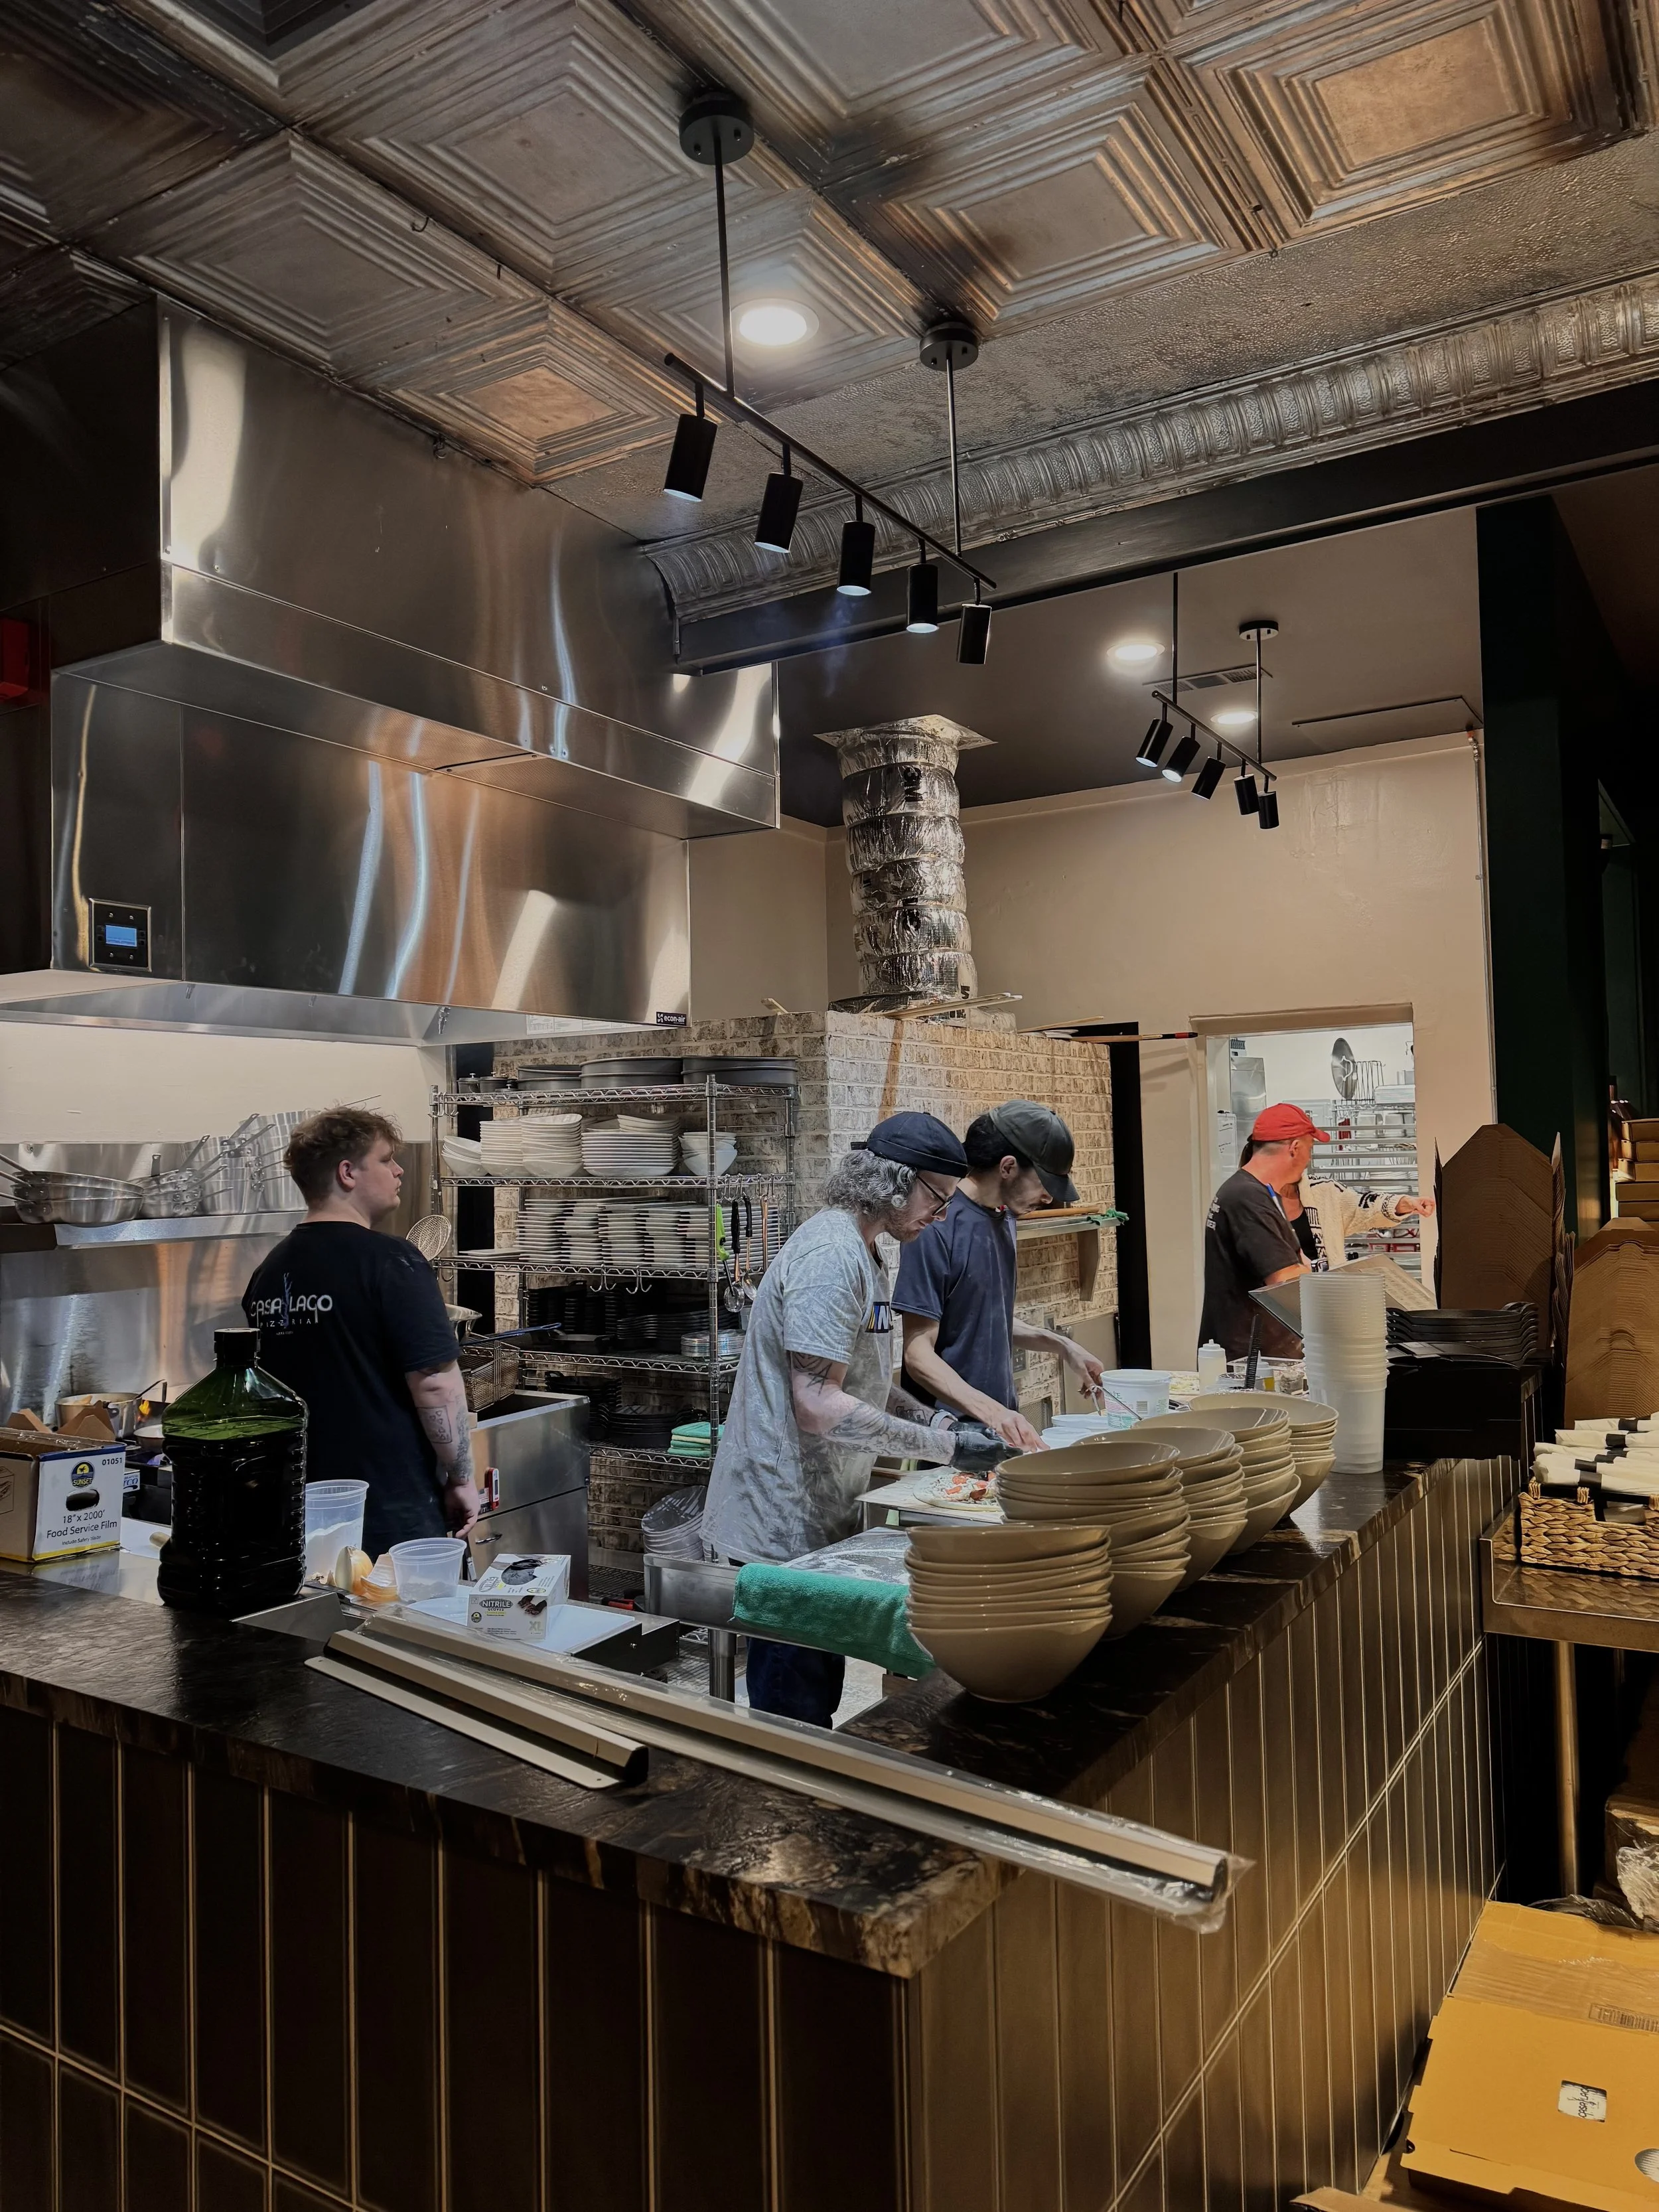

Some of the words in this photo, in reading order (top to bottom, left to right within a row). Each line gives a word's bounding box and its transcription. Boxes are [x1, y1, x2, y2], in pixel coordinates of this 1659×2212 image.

[251, 1297, 282, 1327] CASA
[289, 1294, 332, 1323] LAGO
[73, 1477, 92, 1486] SUNSET
[46, 1527, 68, 1538] Food
[70, 1524, 99, 1535] Service
[101, 1520, 117, 1530] Film
[529, 1621, 543, 1631] XL
